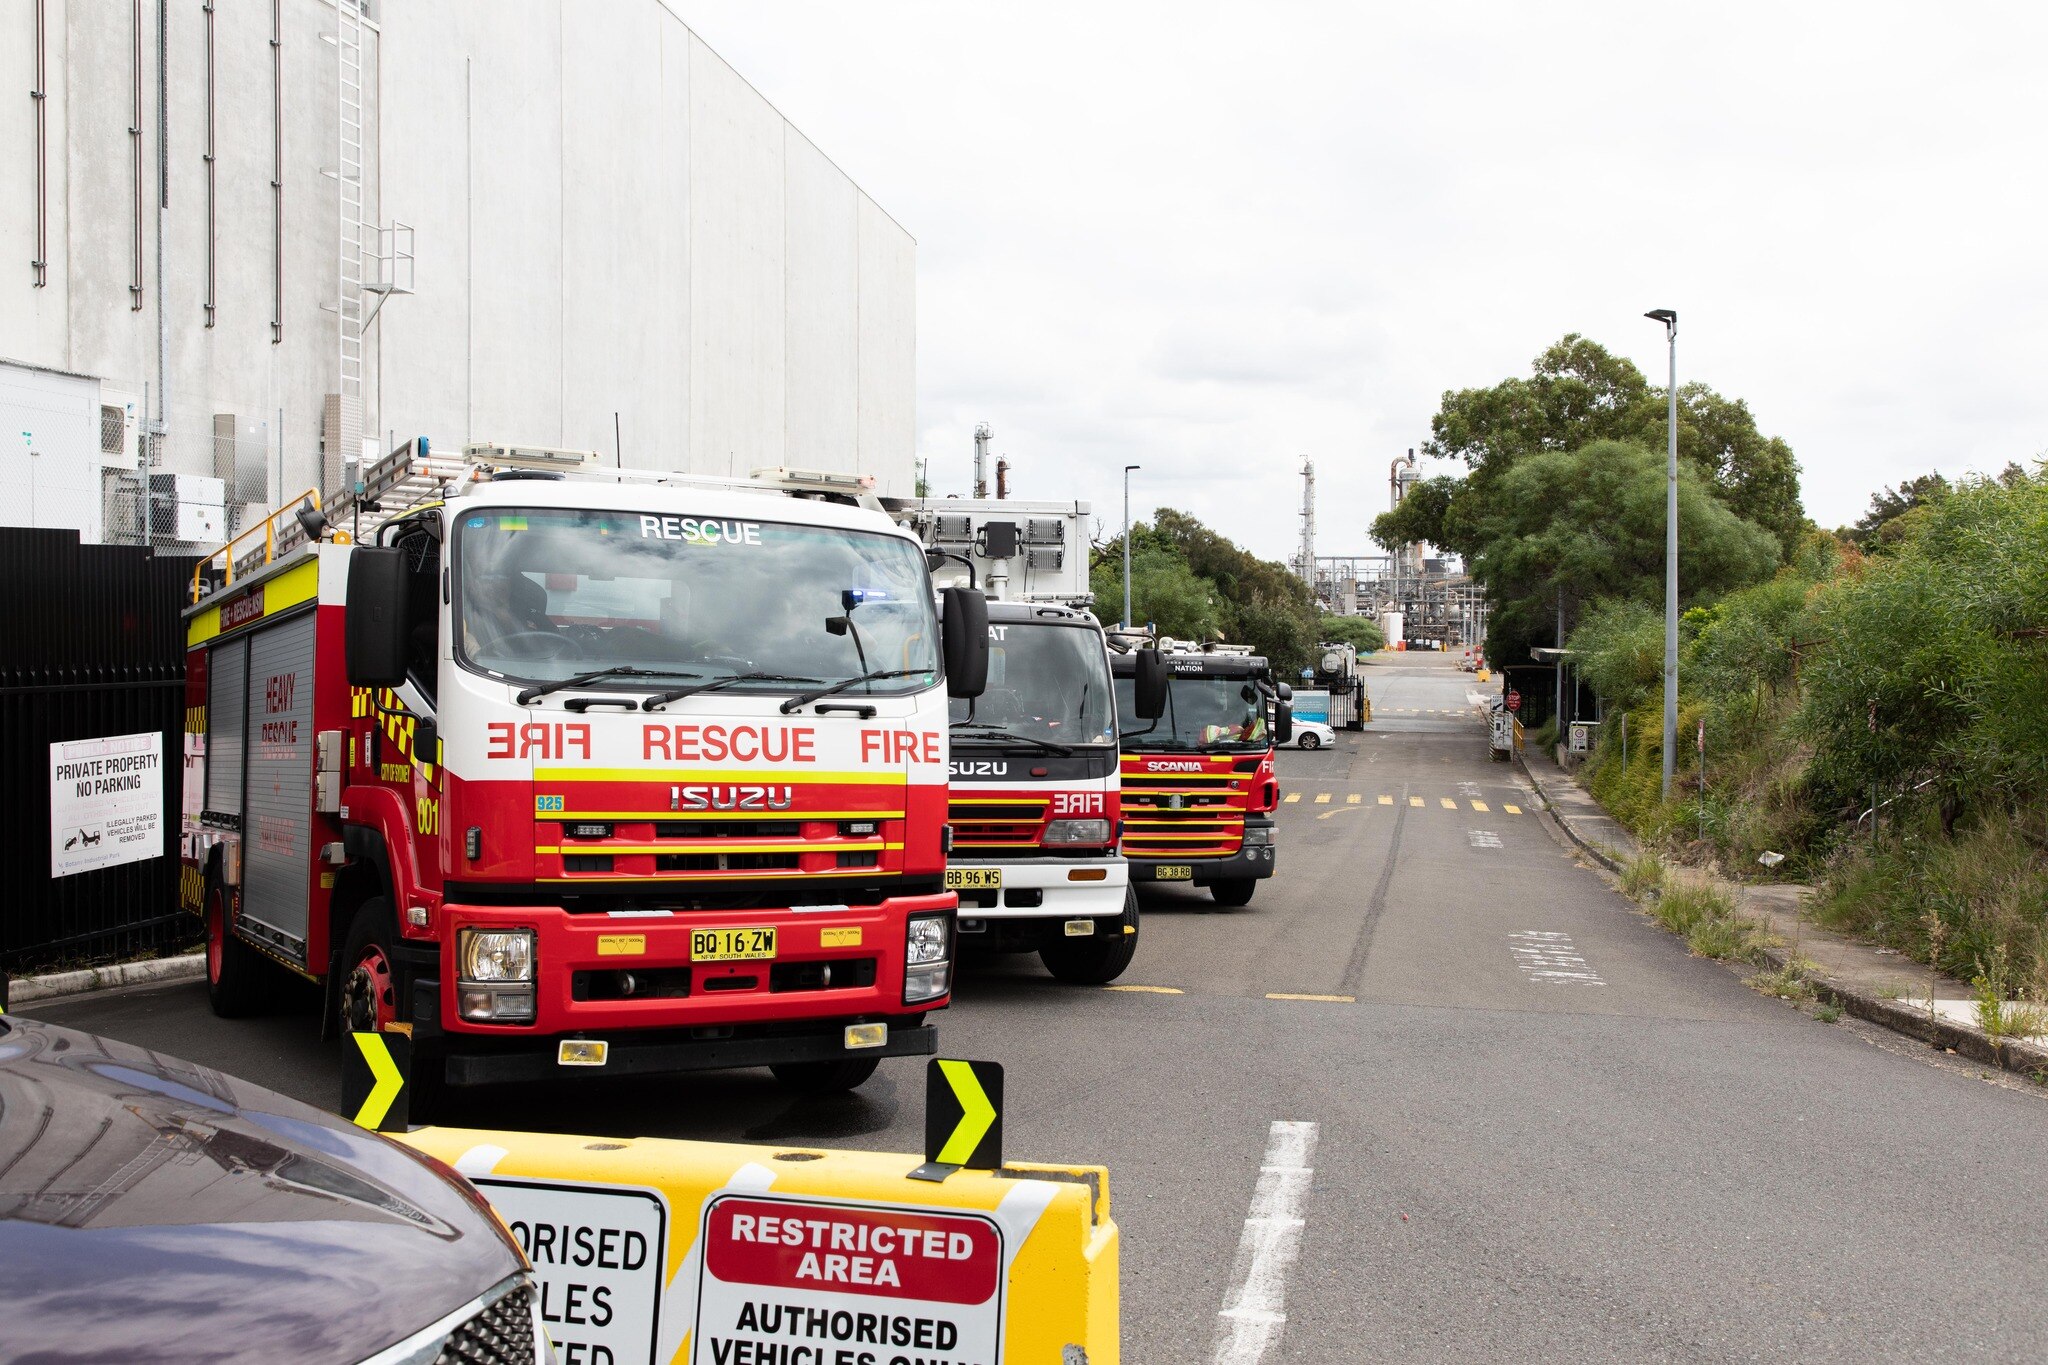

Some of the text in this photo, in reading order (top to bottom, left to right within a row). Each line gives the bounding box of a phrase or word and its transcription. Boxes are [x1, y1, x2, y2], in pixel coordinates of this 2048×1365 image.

[640, 516, 762, 546] RESCUE
[988, 625, 1008, 641] AT
[266, 673, 296, 714] HEAVY
[643, 724, 941, 764] RESCUE FIRE
[56, 759, 103, 781] PRIVATE
[105, 753, 159, 775] PROPERTY
[1147, 761, 1203, 772] SCANIA
[76, 774, 141, 798] NO PARKING
[670, 786, 792, 811] ISUZU
[417, 797, 439, 836] 001
[537, 796, 562, 810] 925
[106, 813, 158, 828] ILLEGALLY PARKED
[107, 822, 155, 837] VEHICLES WILL BE
[119, 833, 146, 844] REMOVED
[731, 1213, 974, 1261] RESTRICTED
[795, 1252, 901, 1288] AREA
[531, 1280, 613, 1328] LES
[735, 1301, 958, 1352] AUTHORISED
